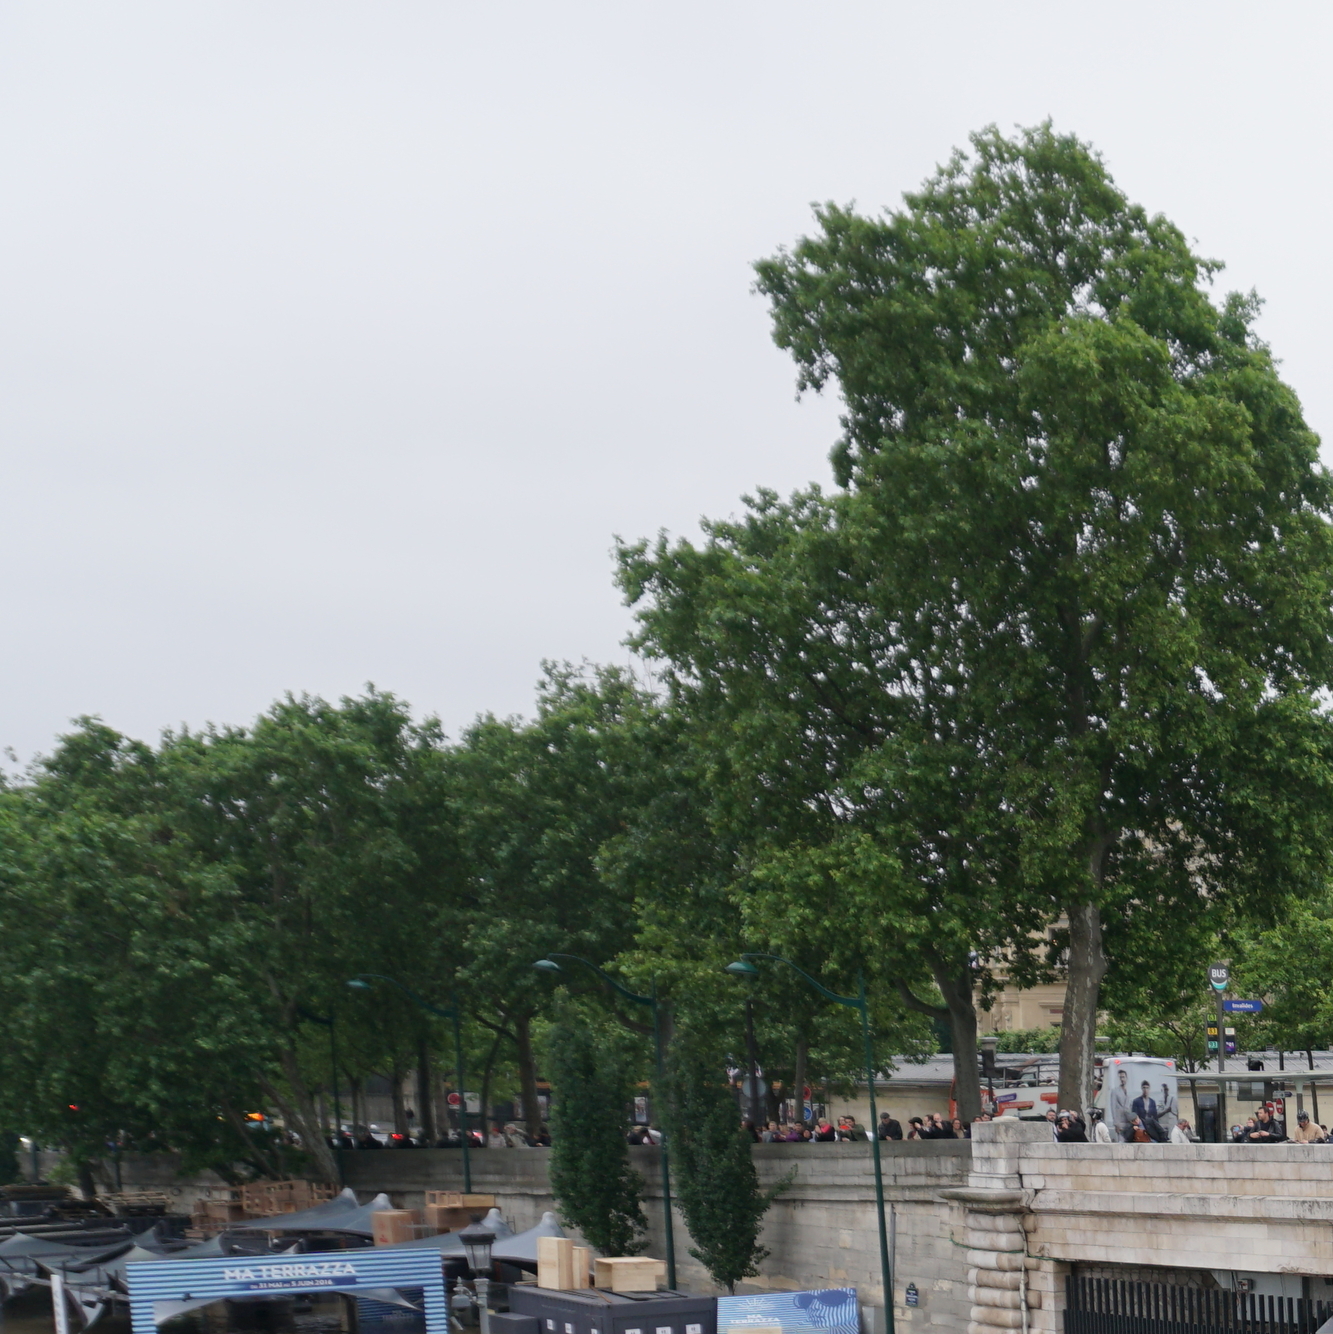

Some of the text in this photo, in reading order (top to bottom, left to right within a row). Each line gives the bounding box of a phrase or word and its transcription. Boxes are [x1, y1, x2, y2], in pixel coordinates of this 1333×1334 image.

[1211, 968, 1227, 978] BUS
[223, 1262, 355, 1280] MA TERRAZZA
[268, 1281, 283, 1289] MAI
[297, 1279, 314, 1287] JUIN
[315, 1278, 333, 1286] 2016
